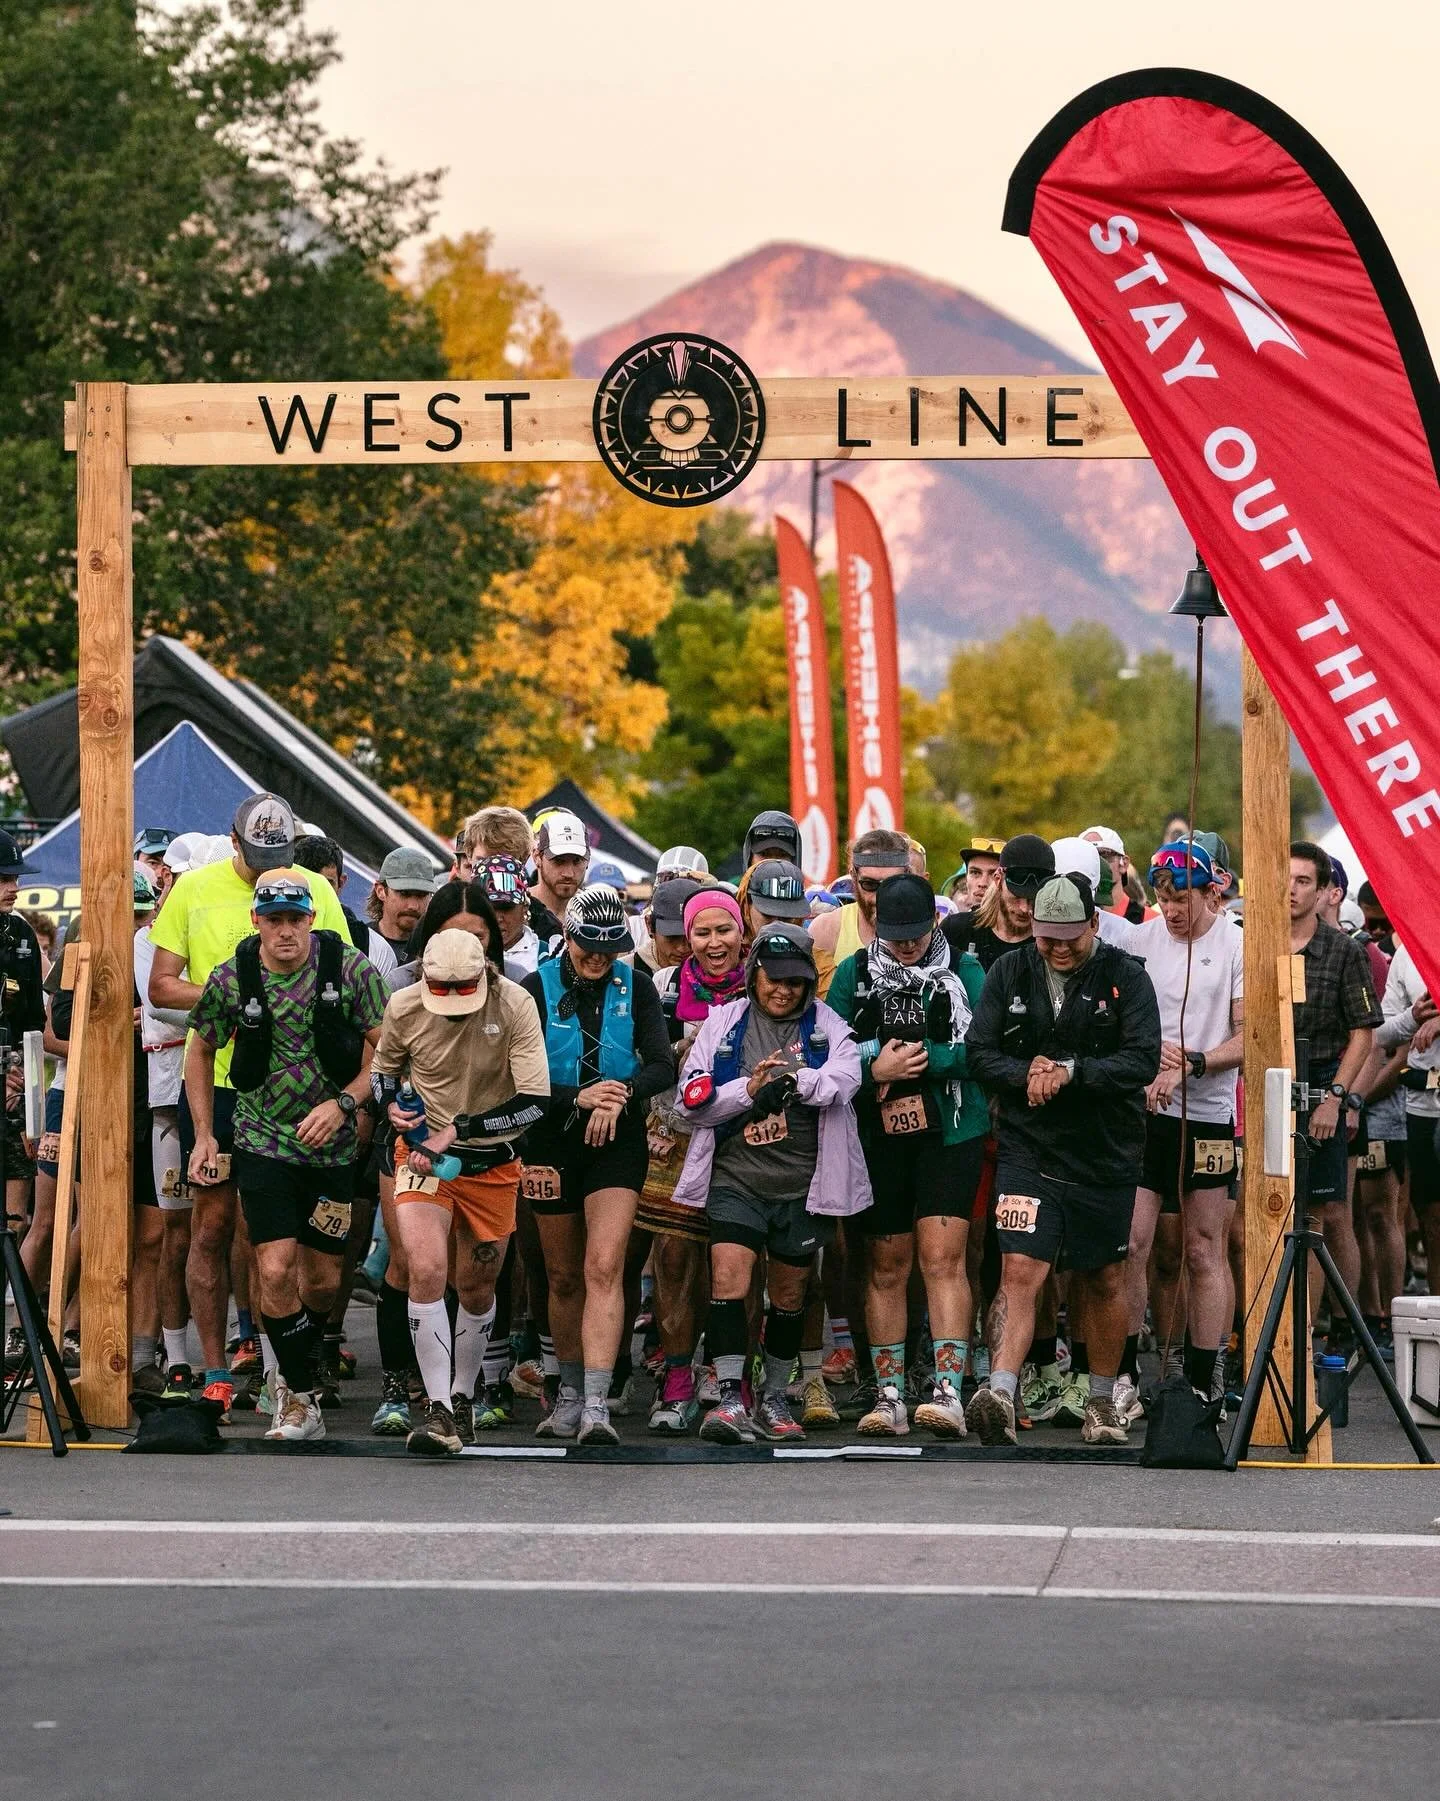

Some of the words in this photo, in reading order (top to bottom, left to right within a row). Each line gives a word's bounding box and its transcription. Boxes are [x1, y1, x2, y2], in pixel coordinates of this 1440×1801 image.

[258, 392, 531, 454] WEST
[838, 387, 1084, 447] LINE
[1089, 215, 1219, 386] STAY
[1203, 426, 1313, 571] OUT
[1296, 598, 1440, 838] THERE
[883, 1010, 926, 1025] EART
[890, 1111, 920, 1132] 293
[751, 1122, 781, 1143] 312
[1206, 1154, 1223, 1172] 61
[408, 1174, 426, 1190] 17
[526, 1179, 553, 1198] 315
[321, 1214, 343, 1235] 79
[1001, 1209, 1029, 1229] 309
